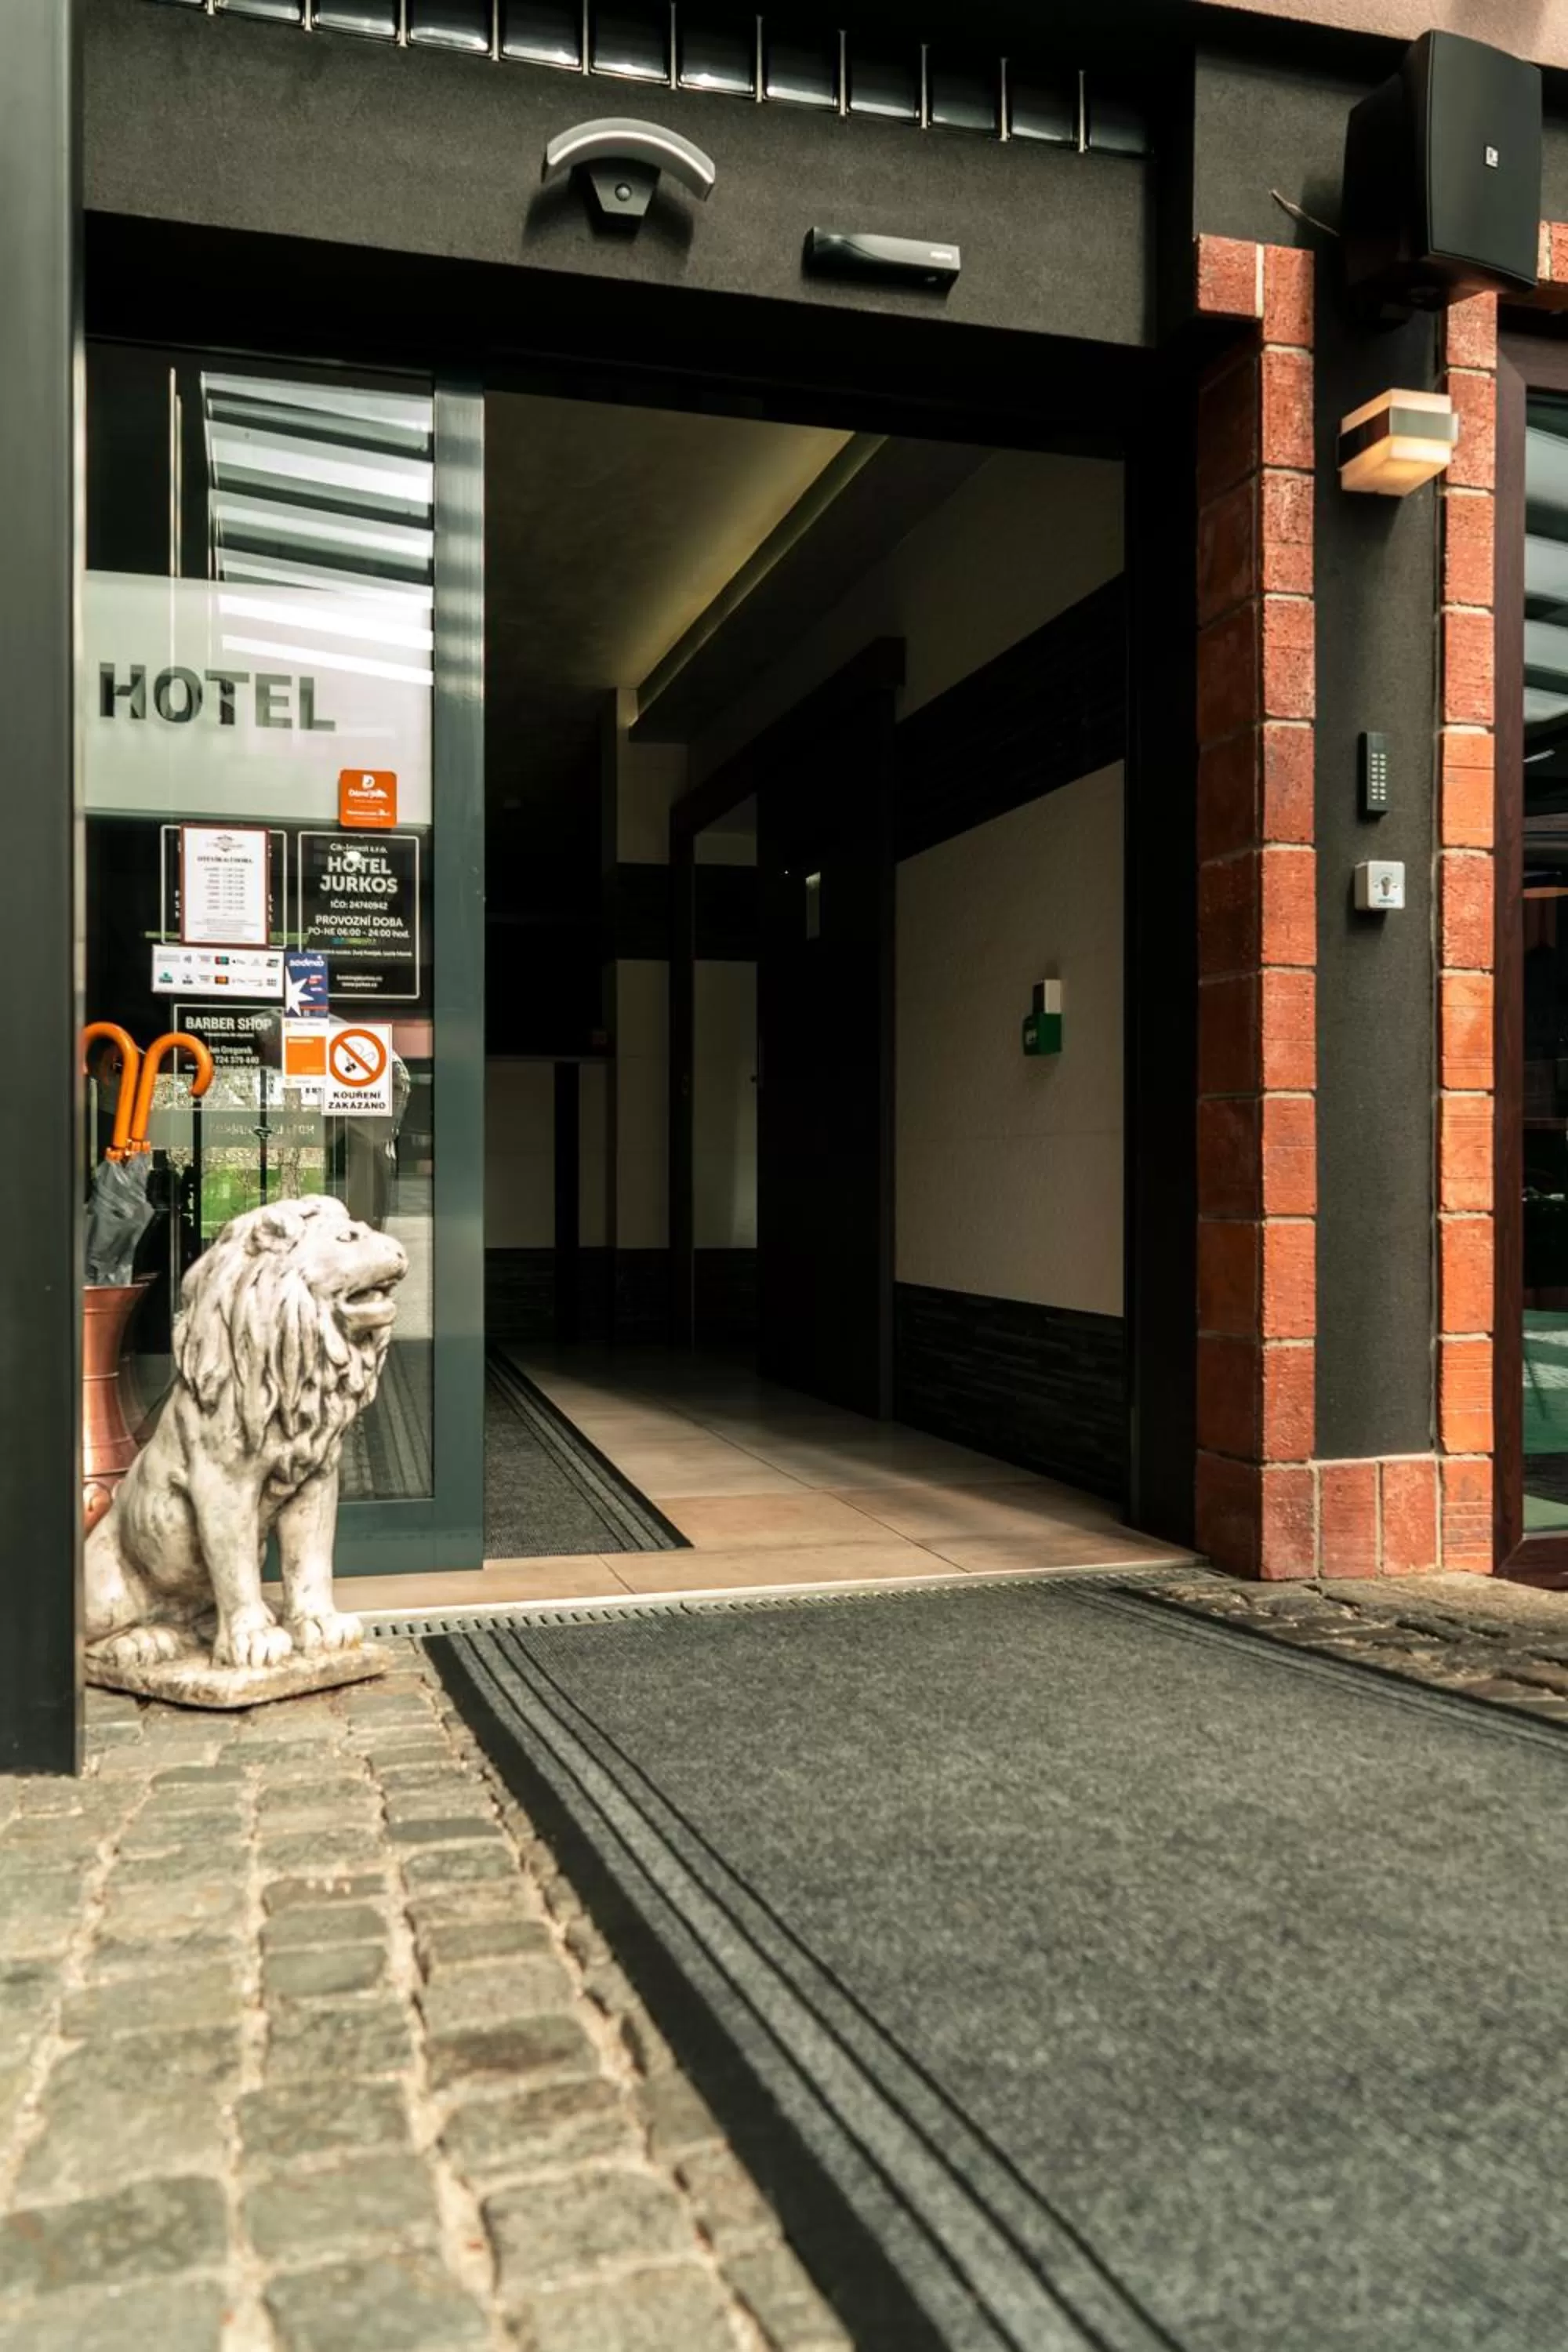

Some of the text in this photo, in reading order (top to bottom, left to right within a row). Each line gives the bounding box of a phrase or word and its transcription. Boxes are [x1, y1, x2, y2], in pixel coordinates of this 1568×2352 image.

[100, 662, 336, 731] HOTEL
[327, 855, 392, 874] HOTEL
[320, 874, 398, 894] JURKOS
[315, 914, 403, 927] PROVOZNÍ DOBA
[184, 1016, 272, 1031] BARBER SHOP
